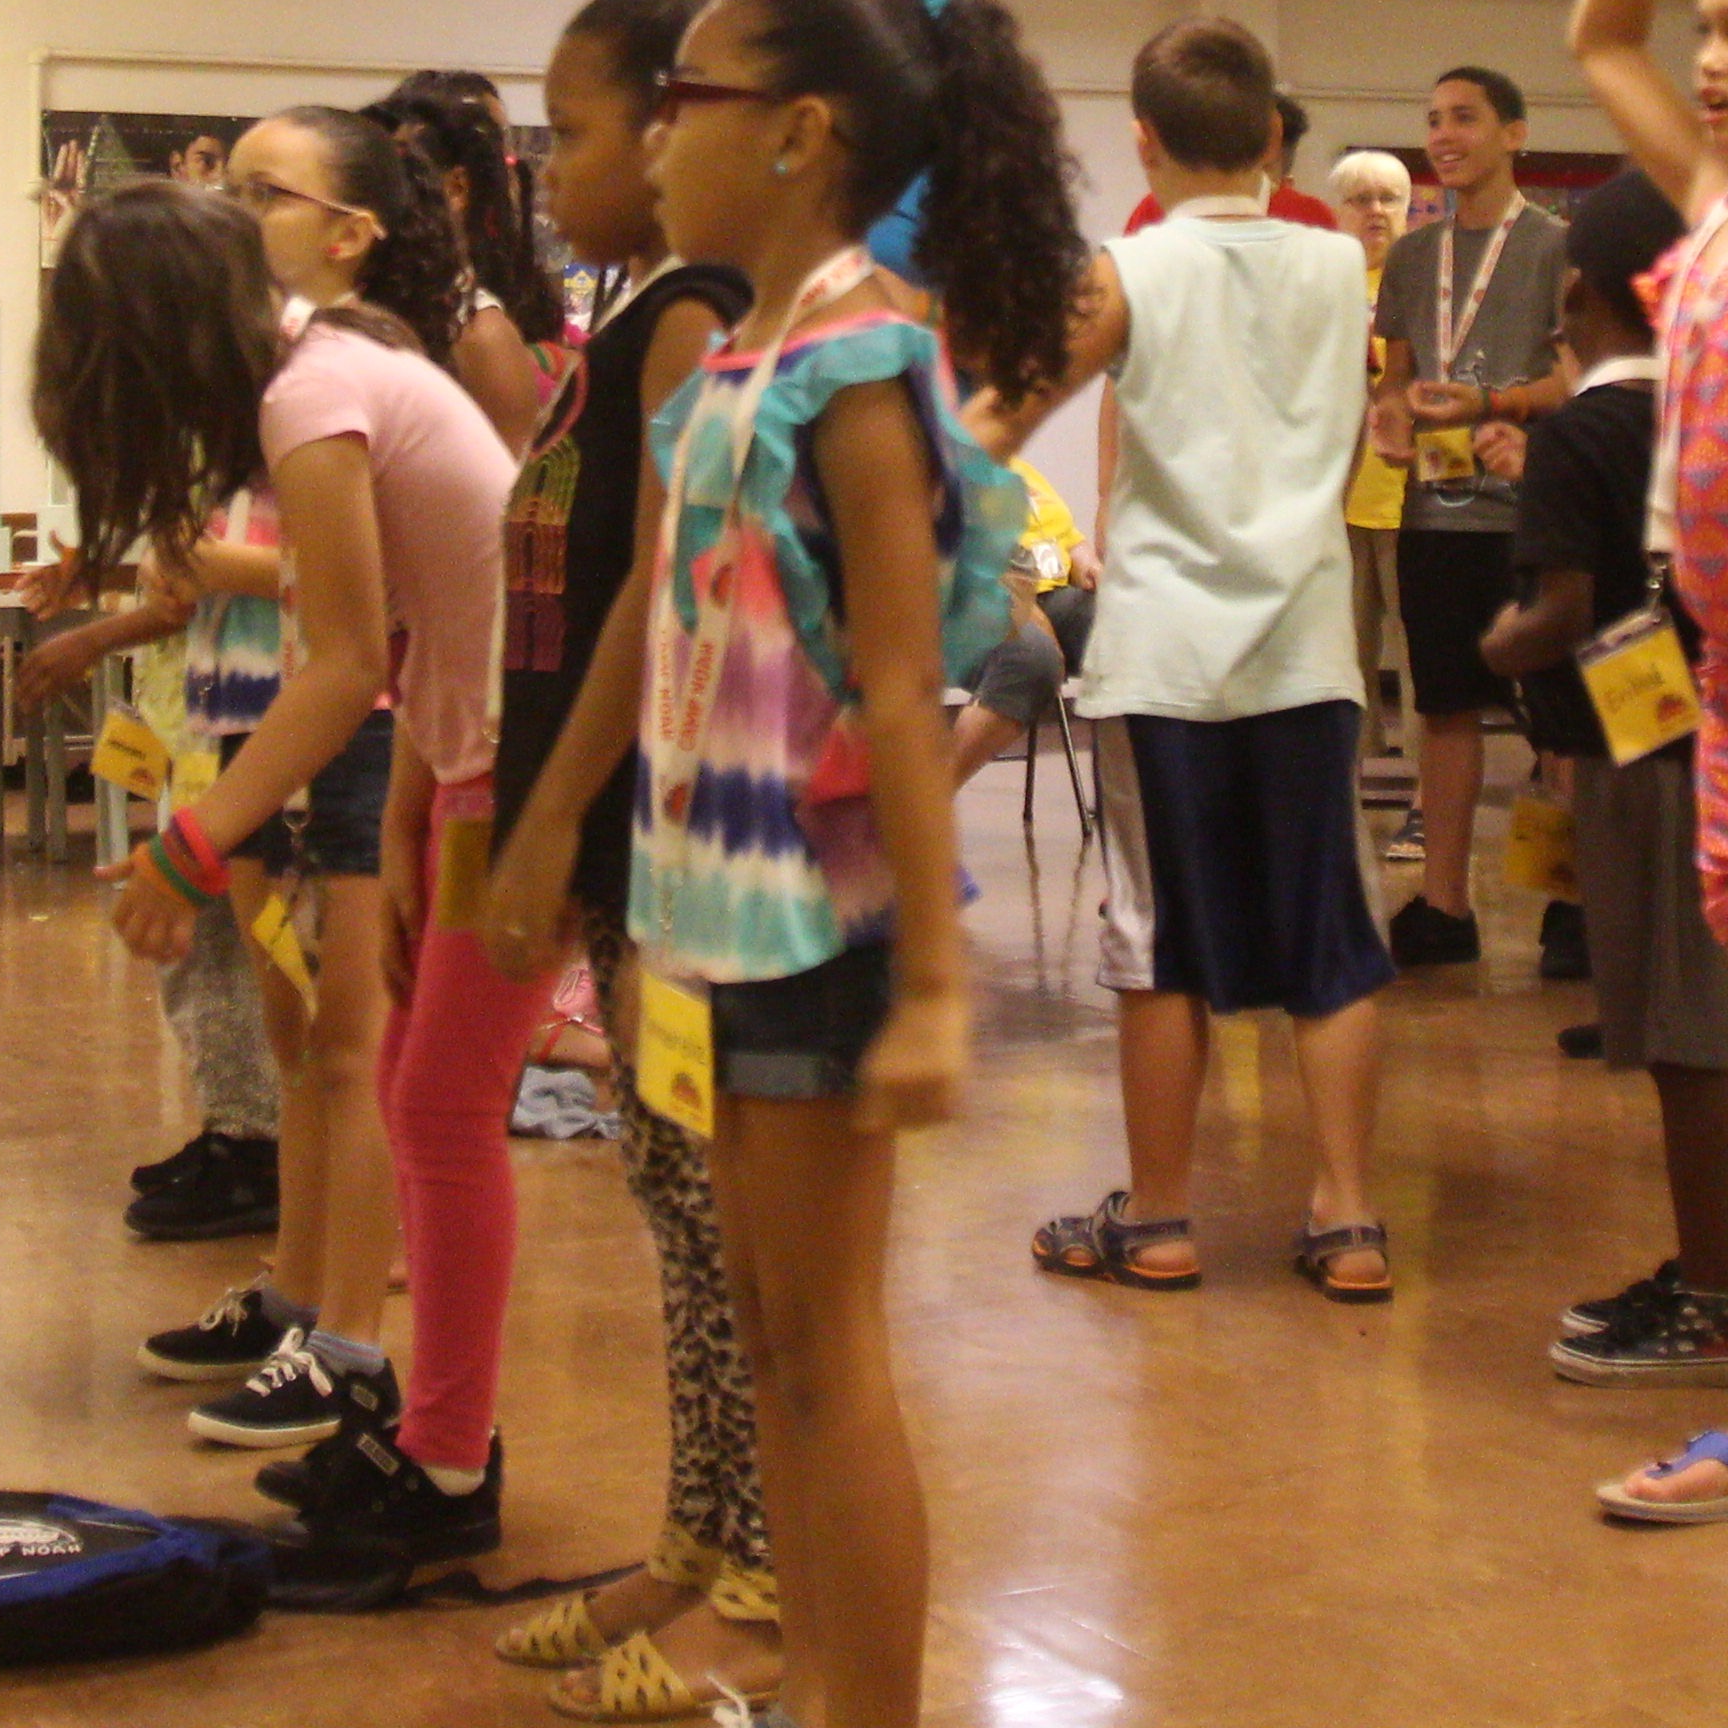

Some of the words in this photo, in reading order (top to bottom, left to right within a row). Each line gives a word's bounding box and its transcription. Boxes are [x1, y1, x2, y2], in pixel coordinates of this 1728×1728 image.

[677, 699, 701, 752] CAMP
[692, 639, 715, 695] NOAH
[21, 1544, 83, 1557] NOAH
